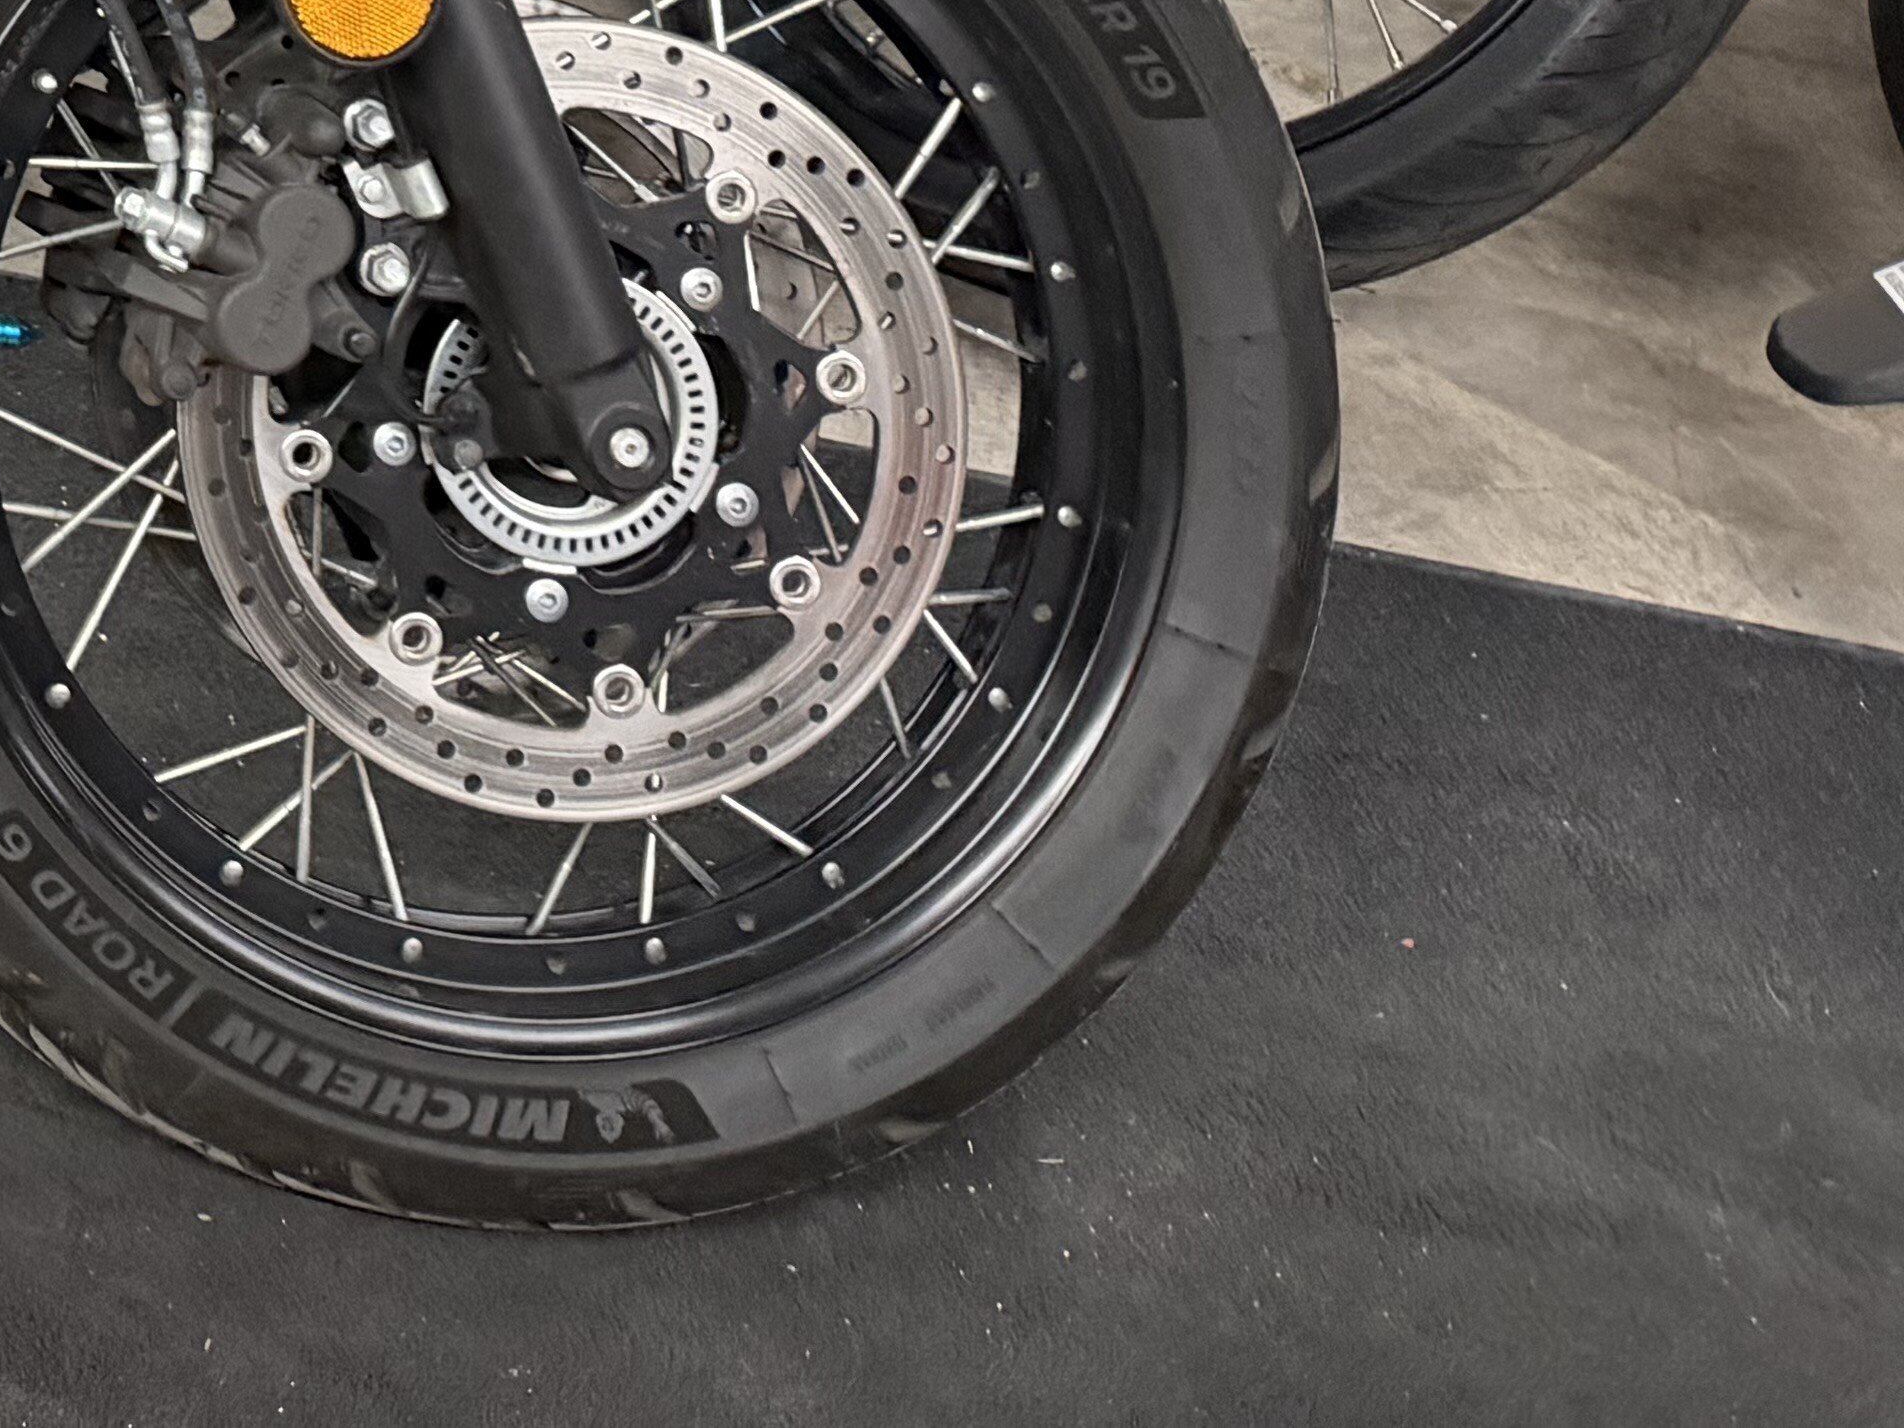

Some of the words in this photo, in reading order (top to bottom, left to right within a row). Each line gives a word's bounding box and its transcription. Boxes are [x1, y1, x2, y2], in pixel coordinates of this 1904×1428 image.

[1122, 45, 1178, 101] 19
[30, 869, 175, 1002] ROAD
[207, 1013, 571, 1143] MICHELIN
